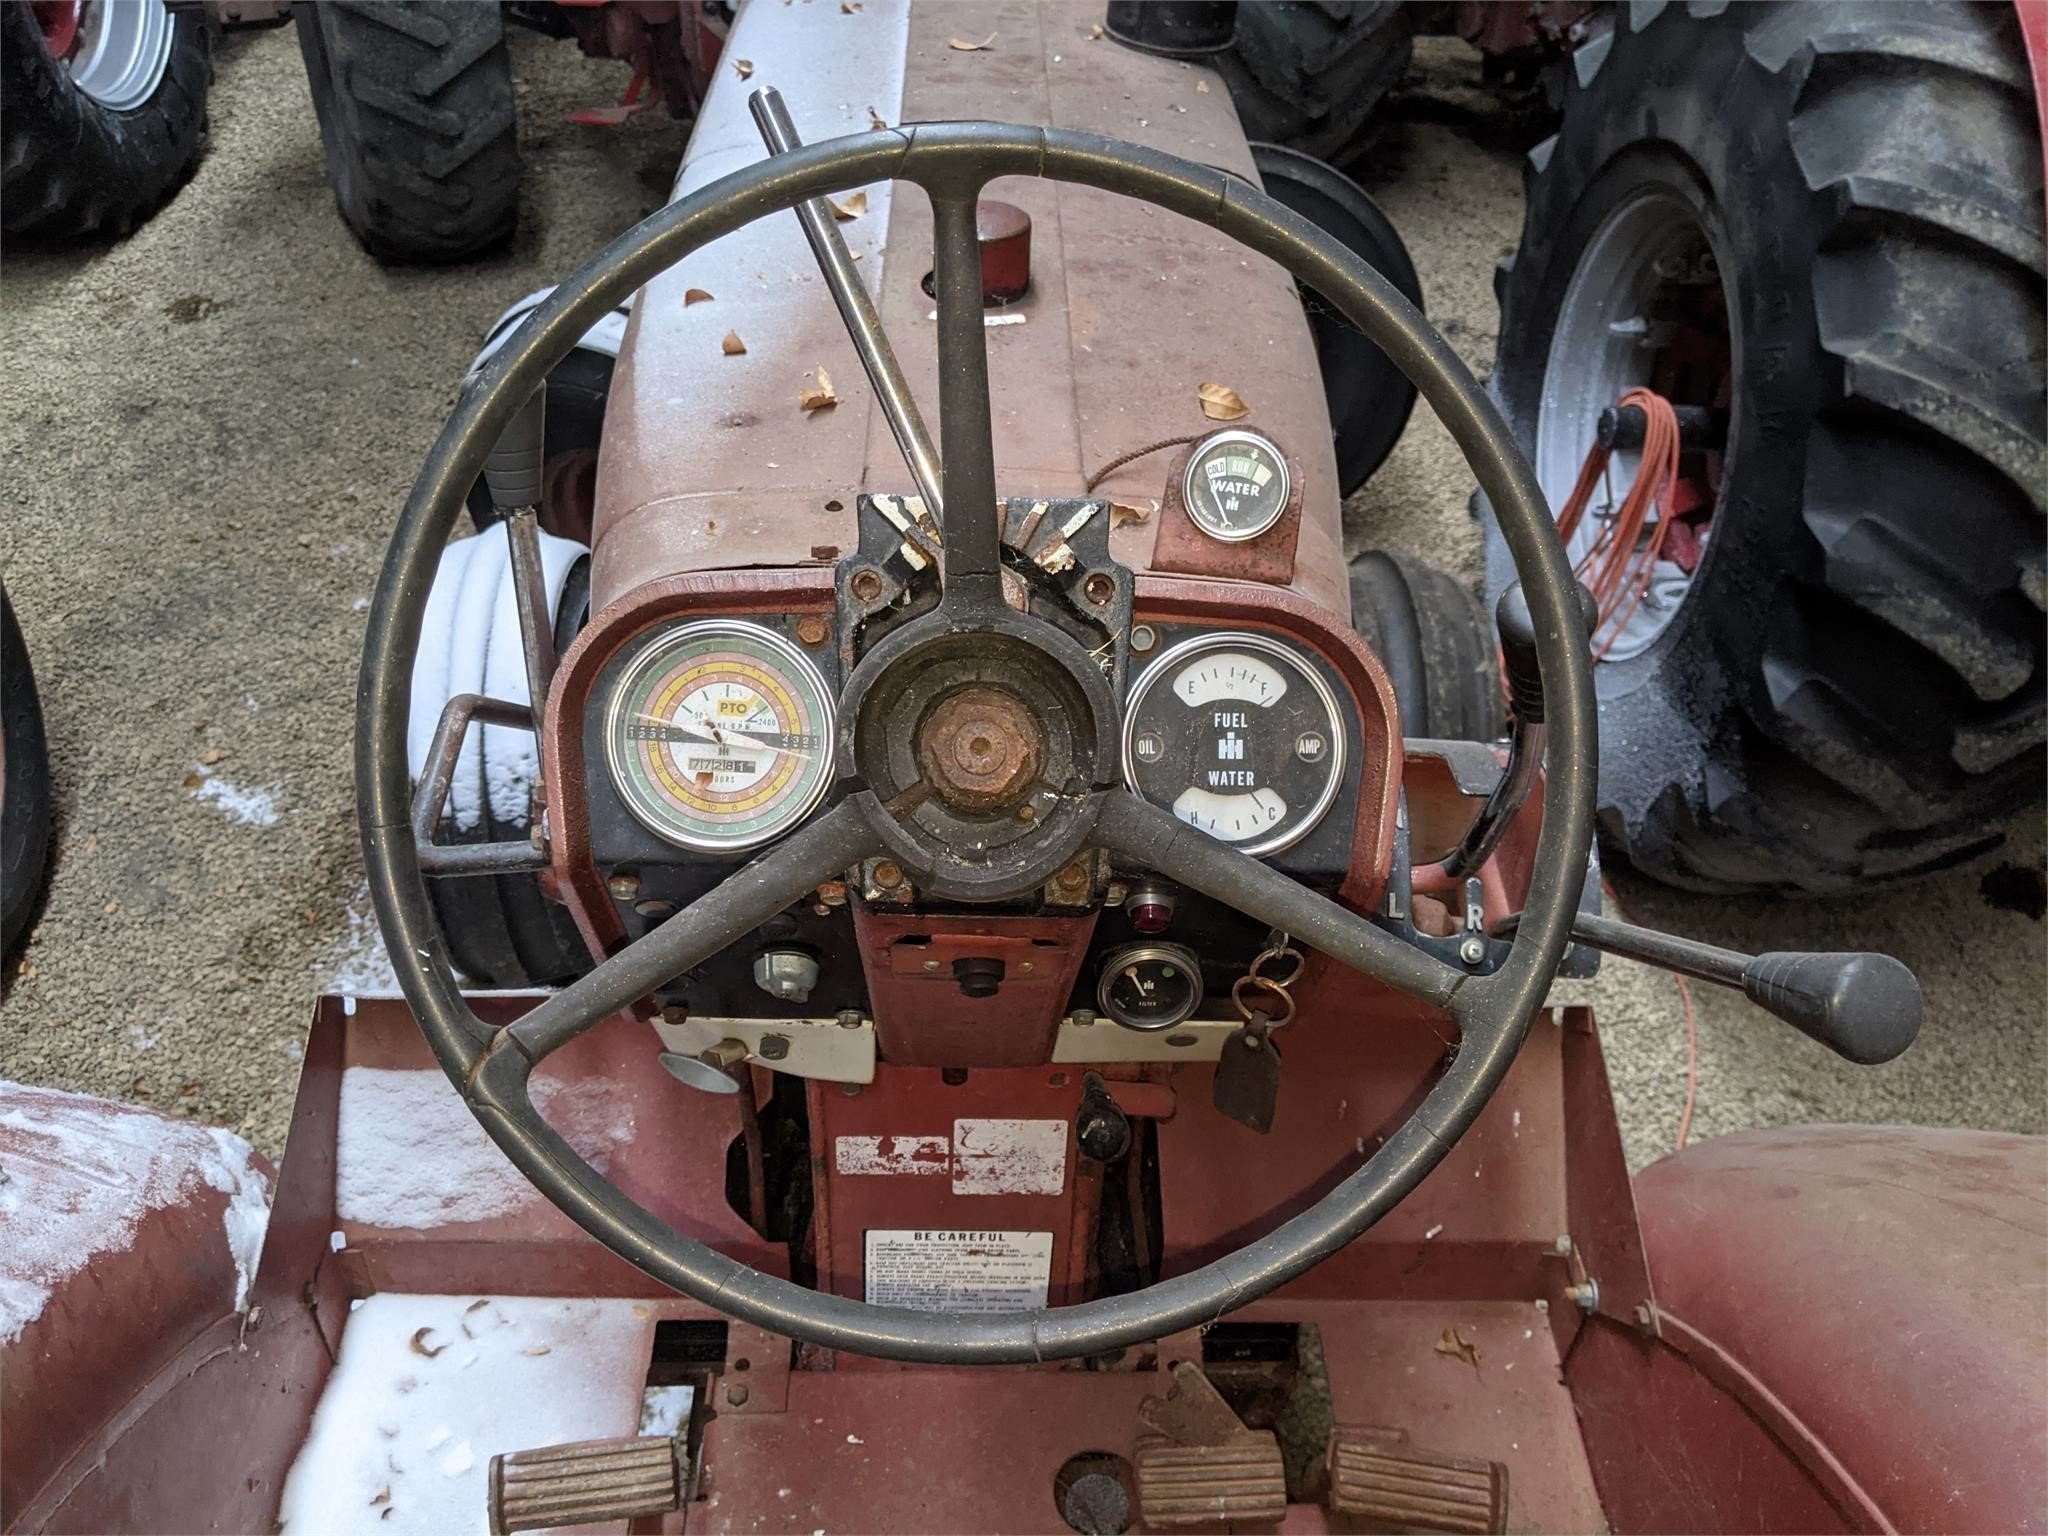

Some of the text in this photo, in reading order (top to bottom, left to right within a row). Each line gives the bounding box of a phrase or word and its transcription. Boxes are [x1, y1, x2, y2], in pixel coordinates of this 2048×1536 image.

[1207, 461, 1225, 476] COLD
[1231, 459, 1251, 474] RUN
[1212, 479, 1260, 496] WATER
[1188, 681, 1268, 695] E F
[720, 702, 747, 714] PTO
[1214, 712, 1249, 728] FUEL
[638, 731, 647, 739] 2
[649, 731, 657, 739] 3
[660, 732, 667, 740] 4
[781, 735, 789, 744] 4
[791, 735, 800, 743] 3
[802, 736, 809, 744] 2
[1138, 740, 1156, 755] OIL
[1299, 739, 1321, 755] AMP
[1208, 770, 1255, 786] WATER
[1190, 807, 1276, 824] H C
[1388, 892, 1405, 919] L
[1467, 904, 1484, 931] R
[914, 1231, 1006, 1242] BE CAREFUL
